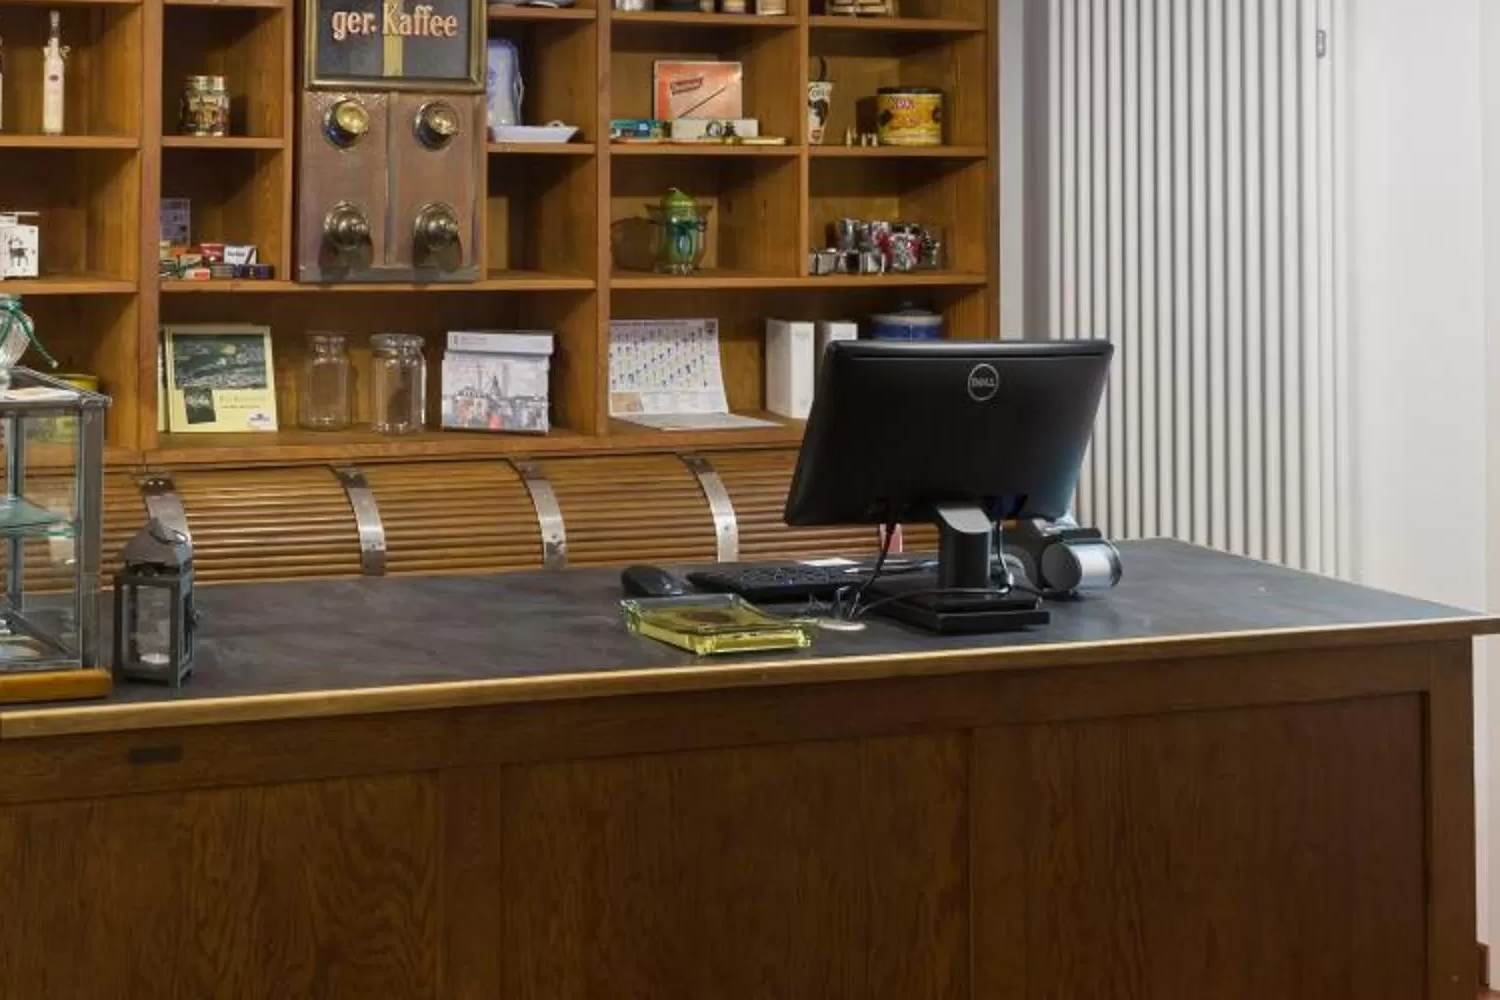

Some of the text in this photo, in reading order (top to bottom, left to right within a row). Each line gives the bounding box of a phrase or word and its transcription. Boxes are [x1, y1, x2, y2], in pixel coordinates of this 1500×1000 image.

[332, 3, 458, 40] ger. Kaffee
[971, 376, 996, 388] DELL
